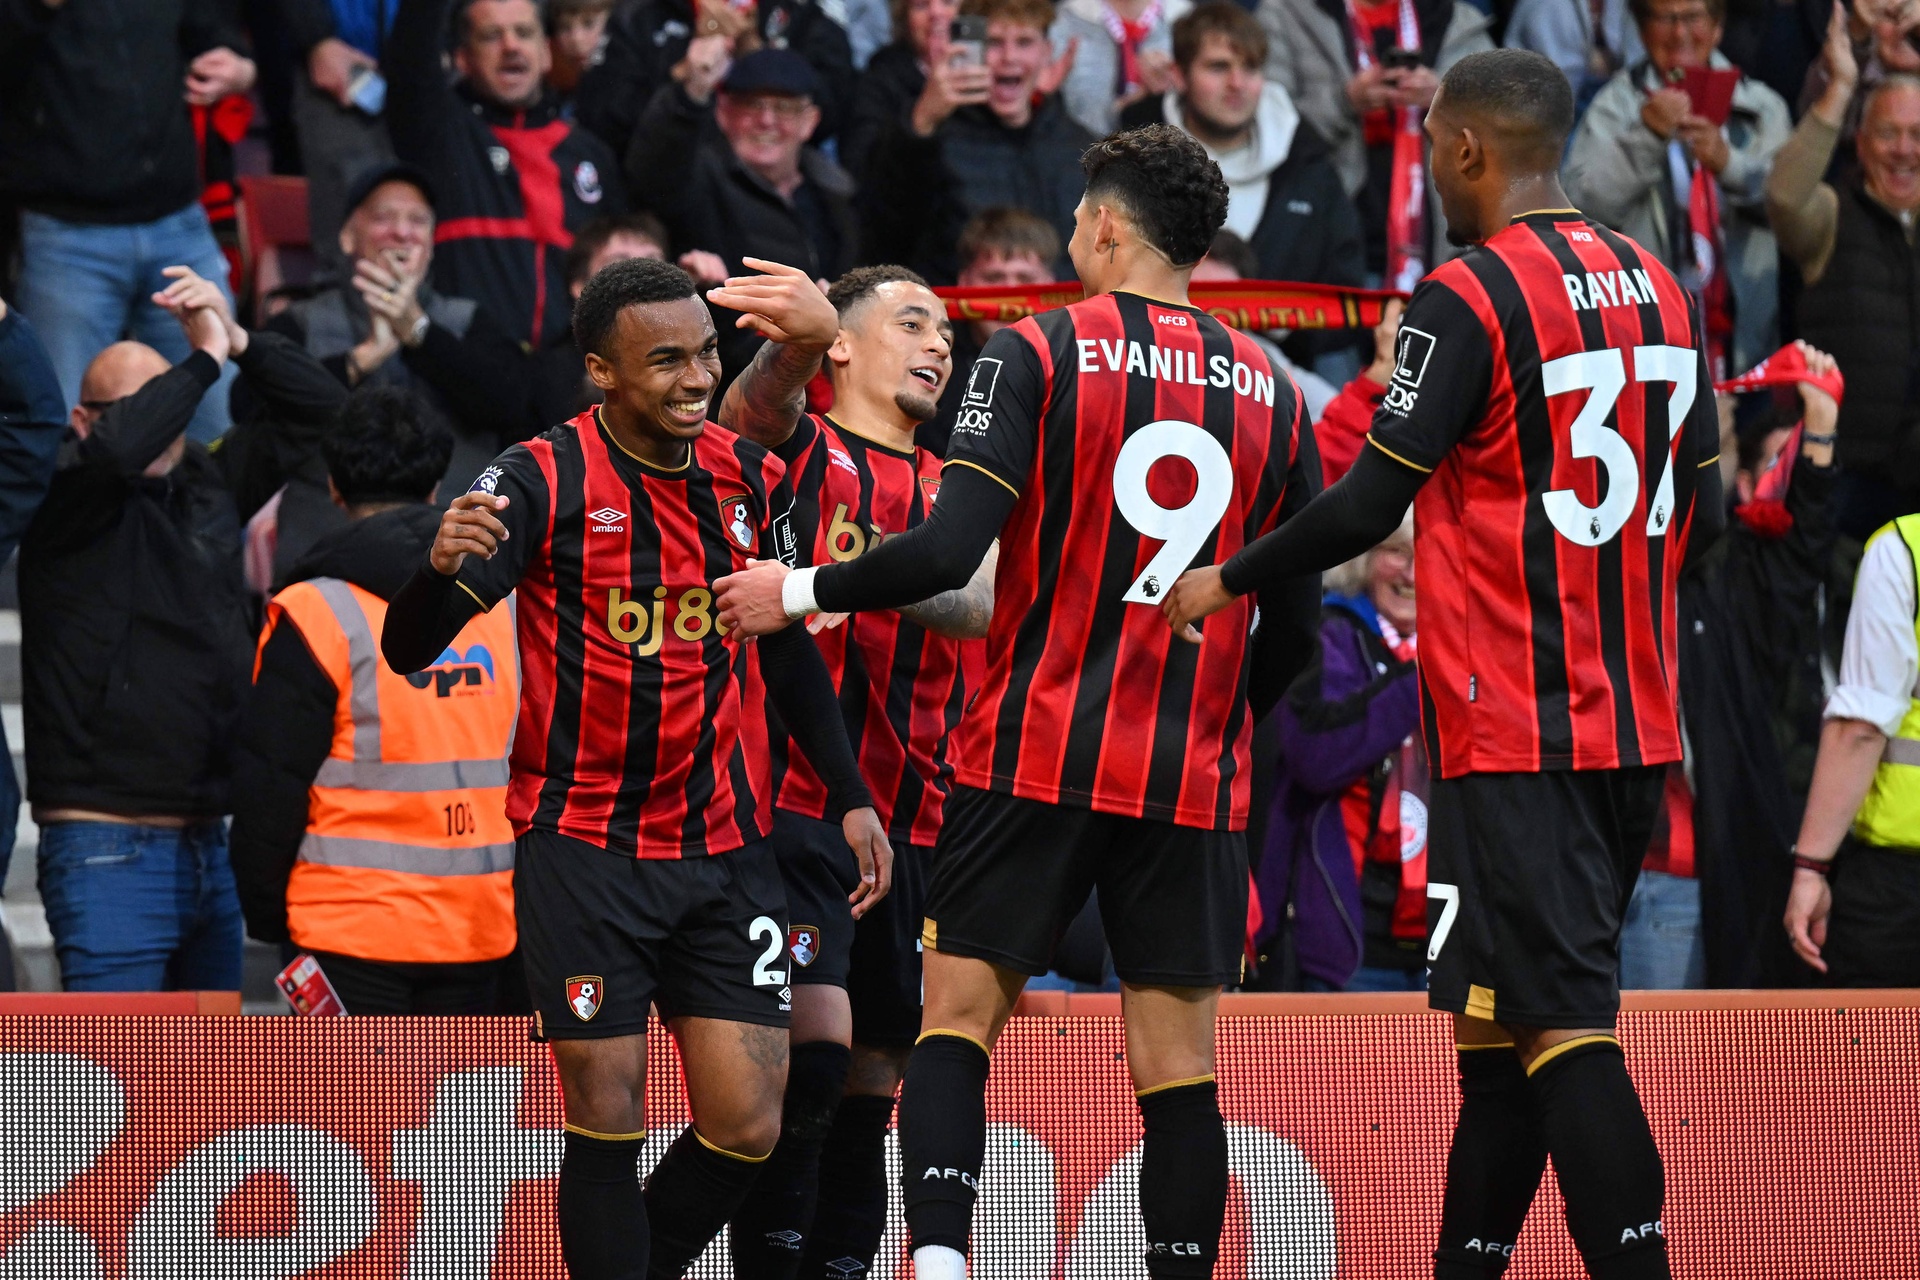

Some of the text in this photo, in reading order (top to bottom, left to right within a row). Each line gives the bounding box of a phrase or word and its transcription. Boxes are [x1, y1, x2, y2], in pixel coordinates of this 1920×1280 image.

[1571, 231, 1594, 242] AFCB
[1562, 268, 1660, 311] RAYAN
[1158, 314, 1188, 327] AFCB
[1076, 338, 1275, 408] EVANILSON
[1541, 344, 1698, 547] 37
[831, 458, 858, 476] umbro
[592, 525, 624, 533] umbro
[1112, 420, 1234, 606] 9
[607, 586, 734, 657] bj8
[923, 1167, 978, 1192] AFCB
